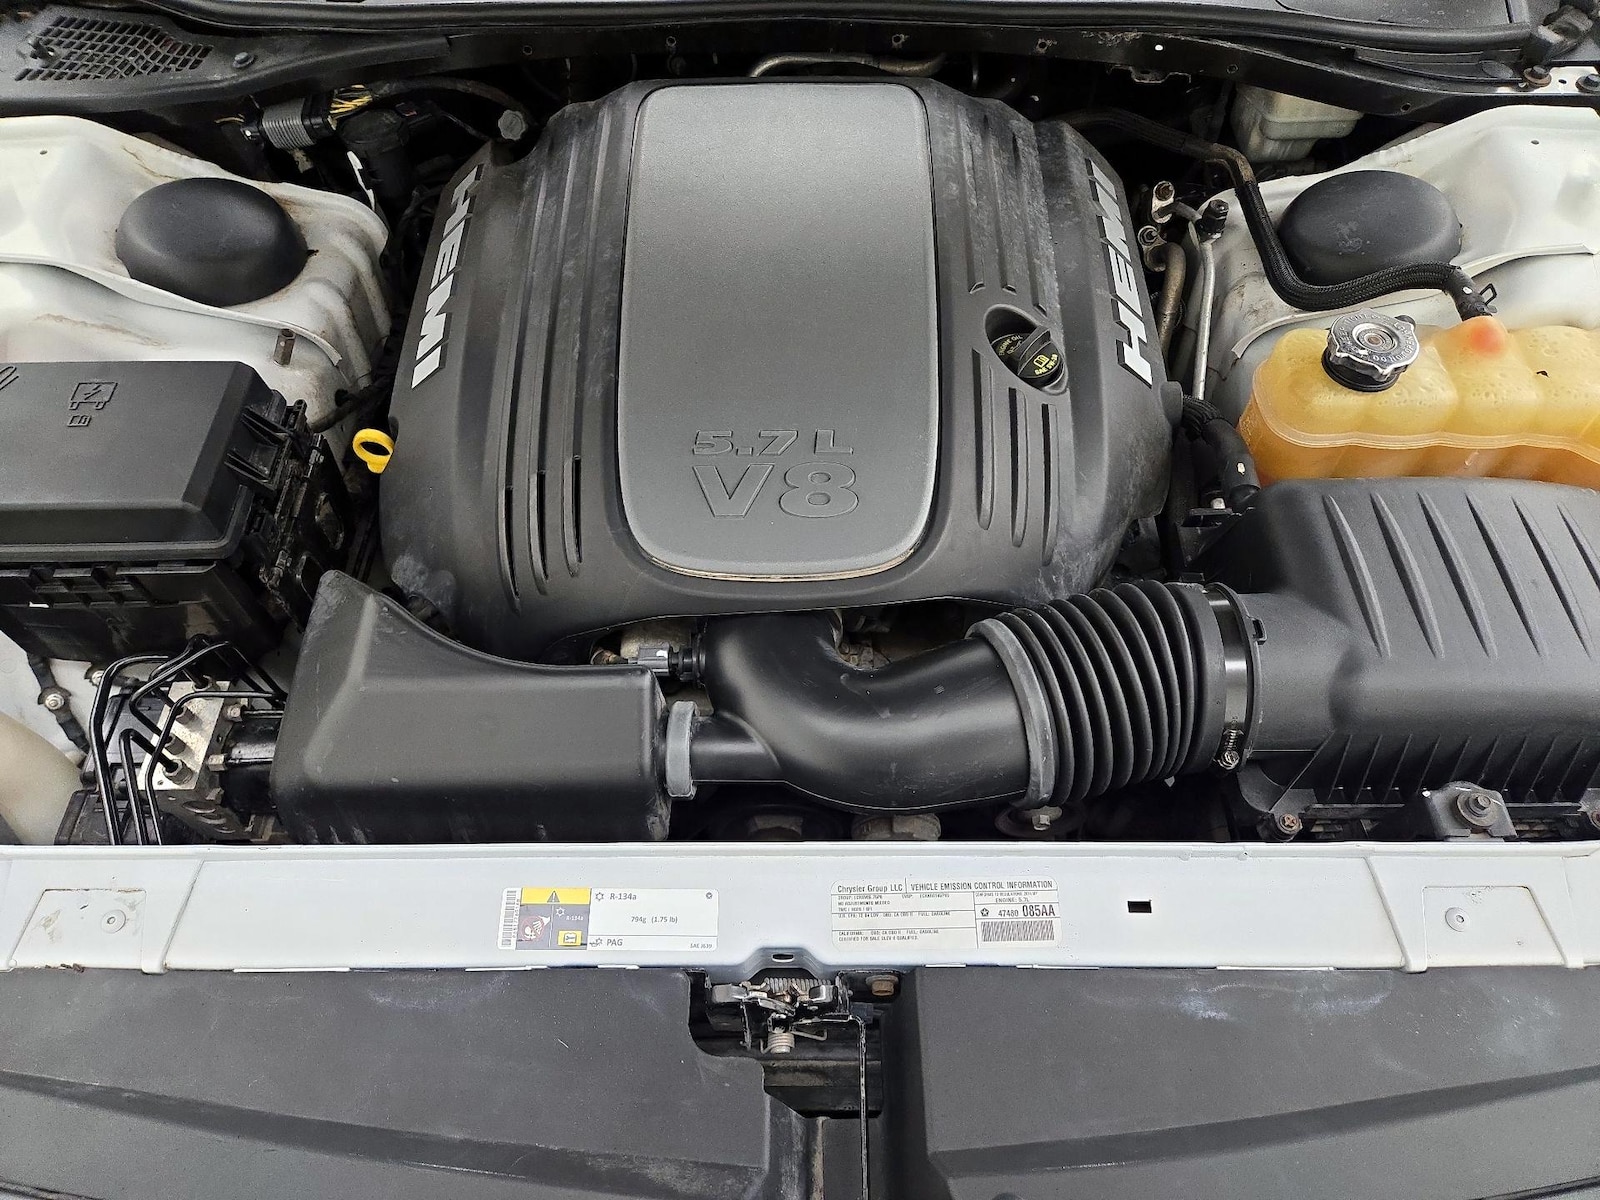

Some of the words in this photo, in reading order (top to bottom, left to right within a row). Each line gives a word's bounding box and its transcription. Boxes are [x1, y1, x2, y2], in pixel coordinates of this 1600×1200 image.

[411, 166, 480, 389] HEMI
[1087, 158, 1153, 389] HEMI
[692, 460, 860, 519] V8
[837, 885, 866, 894] Chrysler
[867, 884, 888, 893] Group
[890, 883, 903, 892] LLC
[910, 882, 938, 891] VEHICLE
[940, 882, 972, 891] EMISSION
[974, 881, 1005, 890] CONTROL
[1006, 880, 1053, 889] INFORMATION
[609, 892, 637, 901] R-134a
[1022, 904, 1056, 917] 085AA
[630, 916, 647, 924] 794g
[651, 916, 668, 924] (1.75
[669, 916, 678, 924] lb)
[606, 938, 623, 946] PAG
